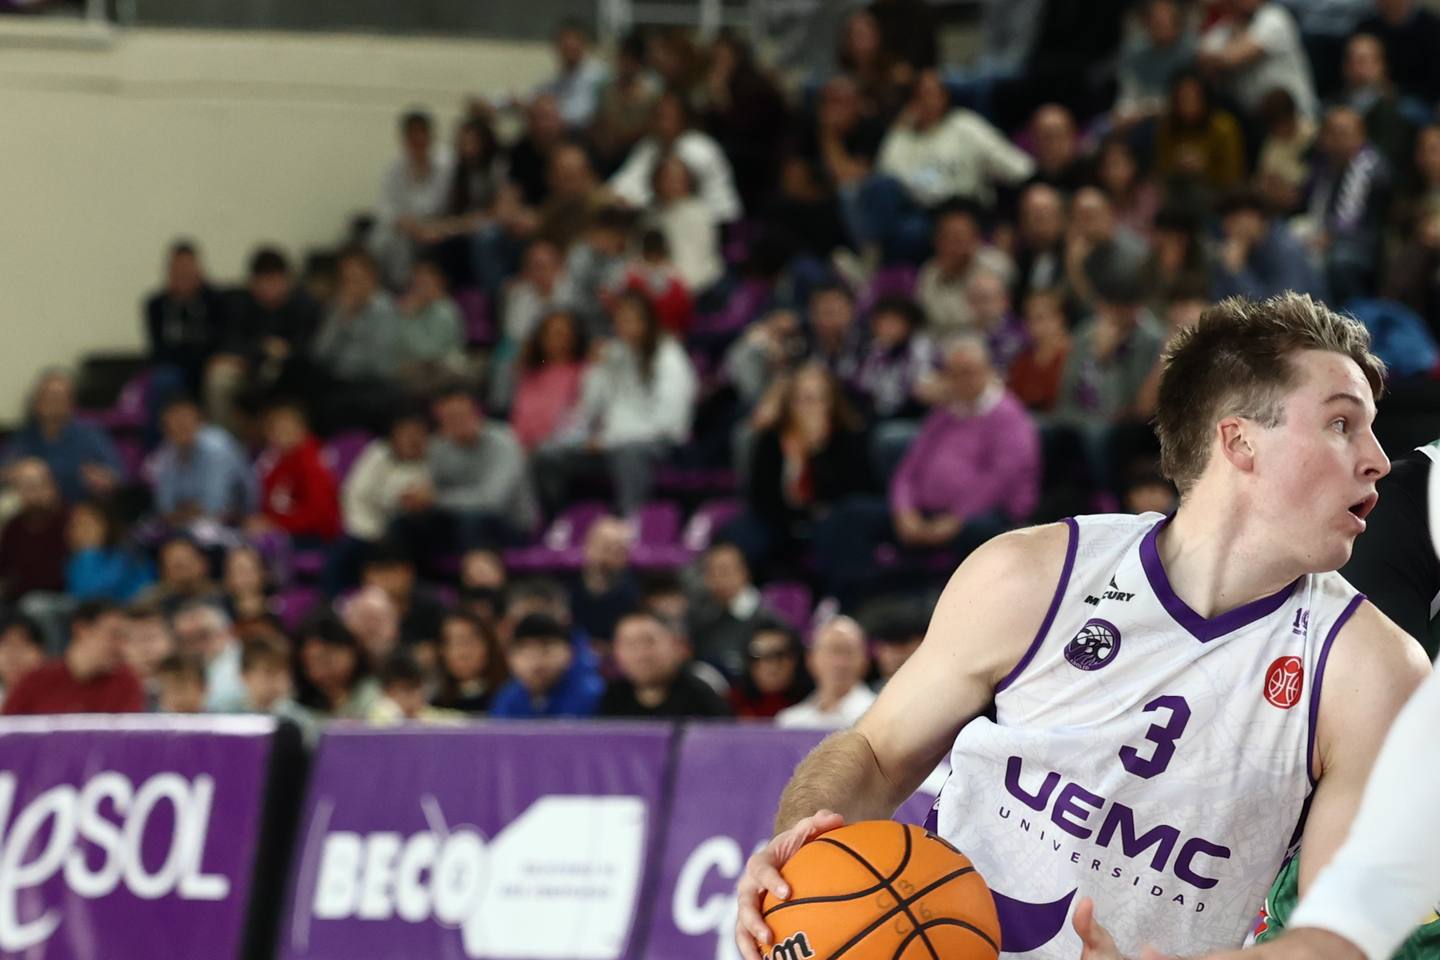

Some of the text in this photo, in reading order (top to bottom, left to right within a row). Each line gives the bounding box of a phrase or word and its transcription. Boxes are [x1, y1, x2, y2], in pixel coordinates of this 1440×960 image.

[1118, 694, 1192, 780] 3
[998, 805, 1206, 914] UNIVERSIDAD
[1004, 755, 1232, 890] UEMC
